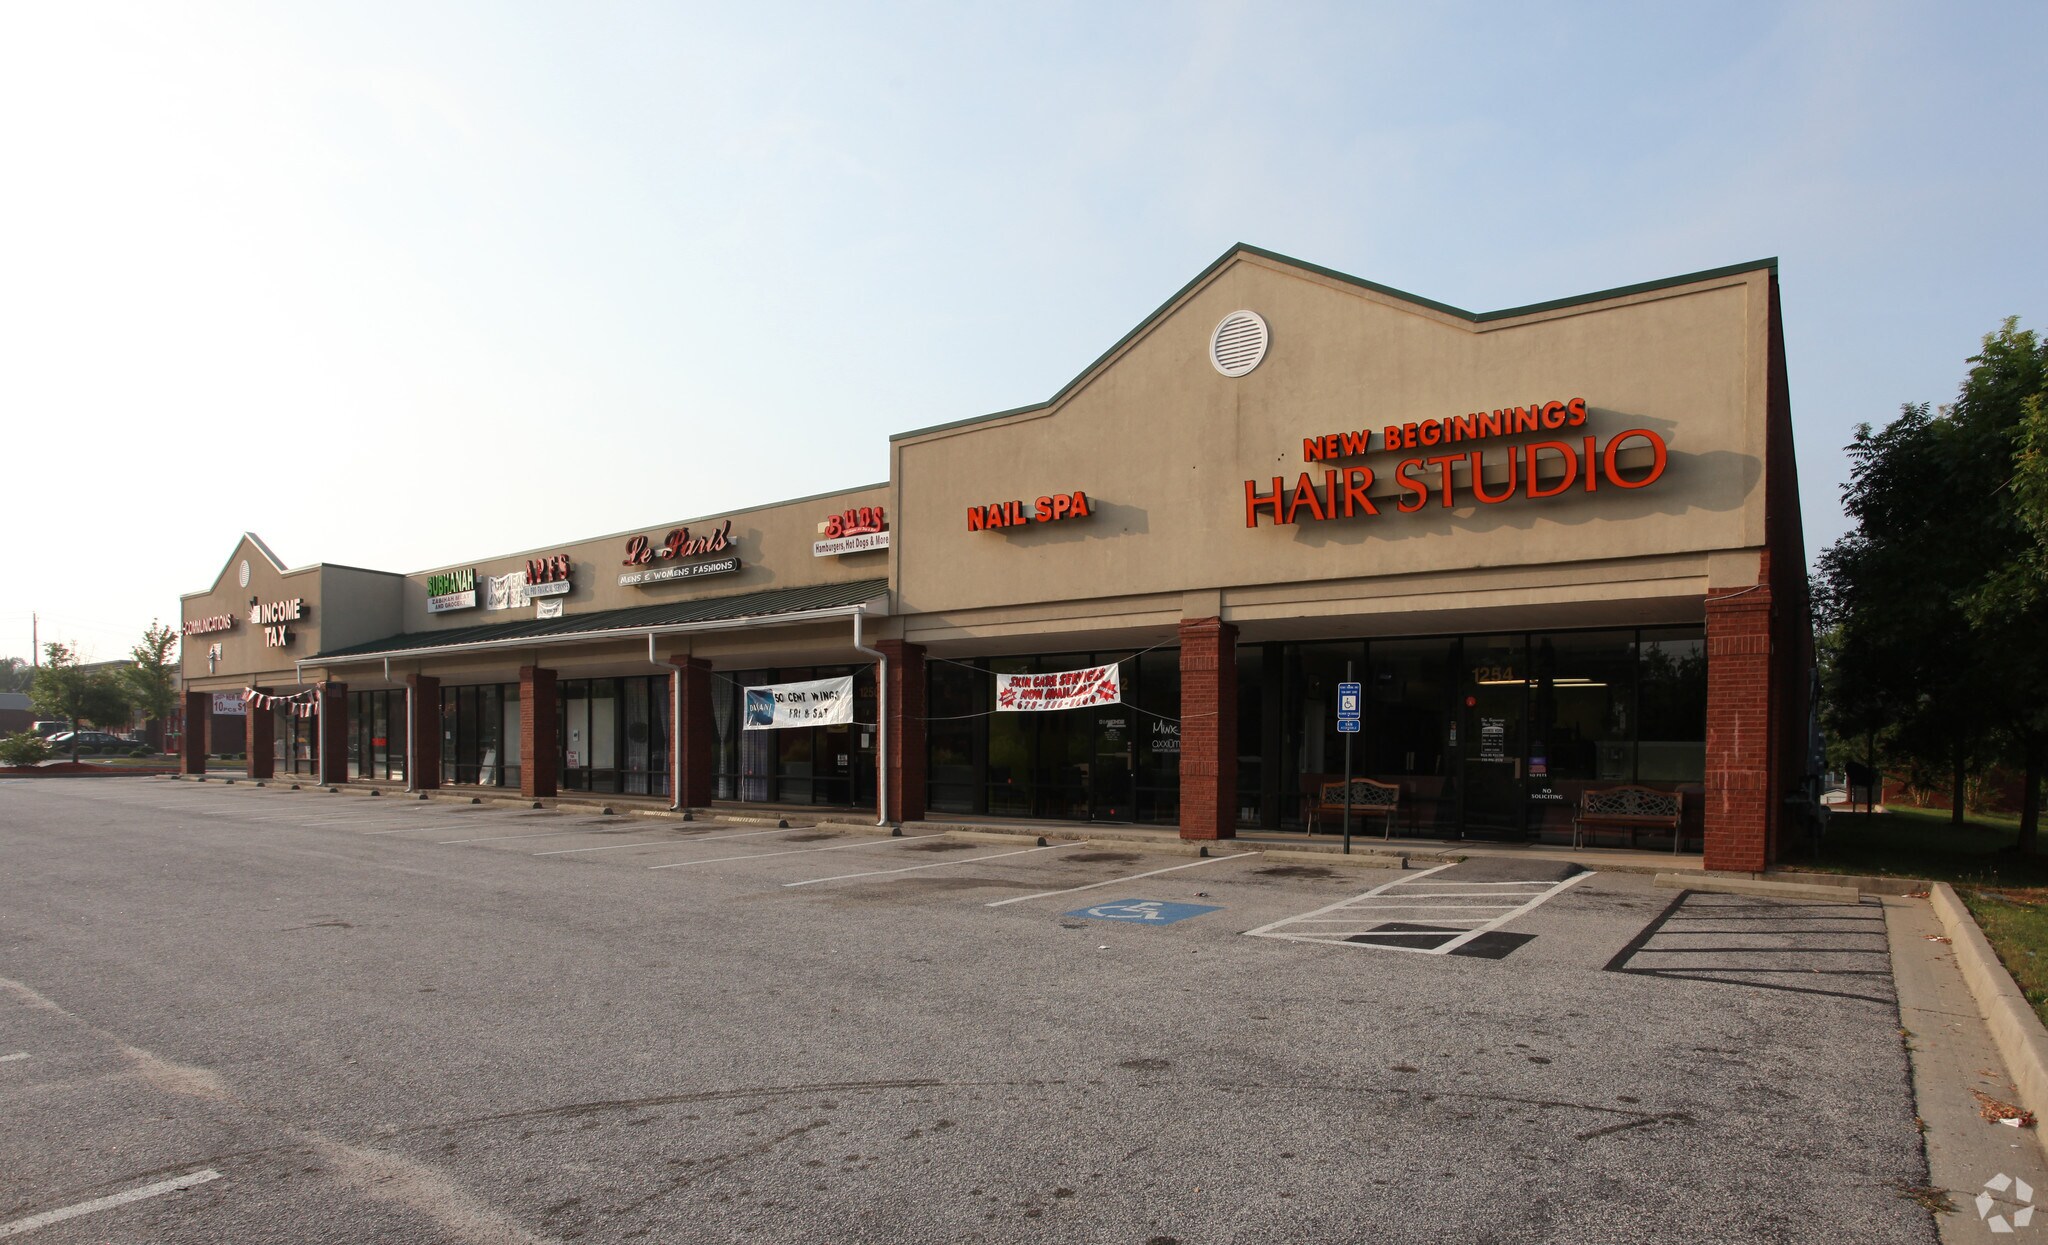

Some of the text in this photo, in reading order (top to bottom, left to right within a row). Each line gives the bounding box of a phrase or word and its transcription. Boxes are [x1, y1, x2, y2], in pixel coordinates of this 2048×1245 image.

[1303, 397, 1589, 462] NEW BEGINNINGS
[1244, 428, 1668, 528] HAIR STUDIO
[968, 491, 1090, 531] NAIL SPA
[622, 535, 653, 566] Le
[815, 535, 888, 554] Hamburgers, Hot Dogs & More
[427, 568, 474, 597] SUBHANAH
[620, 574, 641, 584] MENS
[653, 568, 689, 580] WOMENS
[693, 561, 732, 575] FASHIONS
[262, 598, 300, 624] INCOME
[445, 600, 466, 608] GROCERY
[265, 625, 286, 647] TAX
[1009, 676, 1031, 687] SKIN
[1033, 675, 1057, 687] CARE
[1060, 668, 1106, 686] SERVICES
[1472, 666, 1514, 682] 1254
[774, 690, 839, 703] 50 CENT WINGS
[1020, 688, 1043, 700] NOW
[214, 701, 224, 711] 10
[789, 708, 828, 718] FRI & SAT
